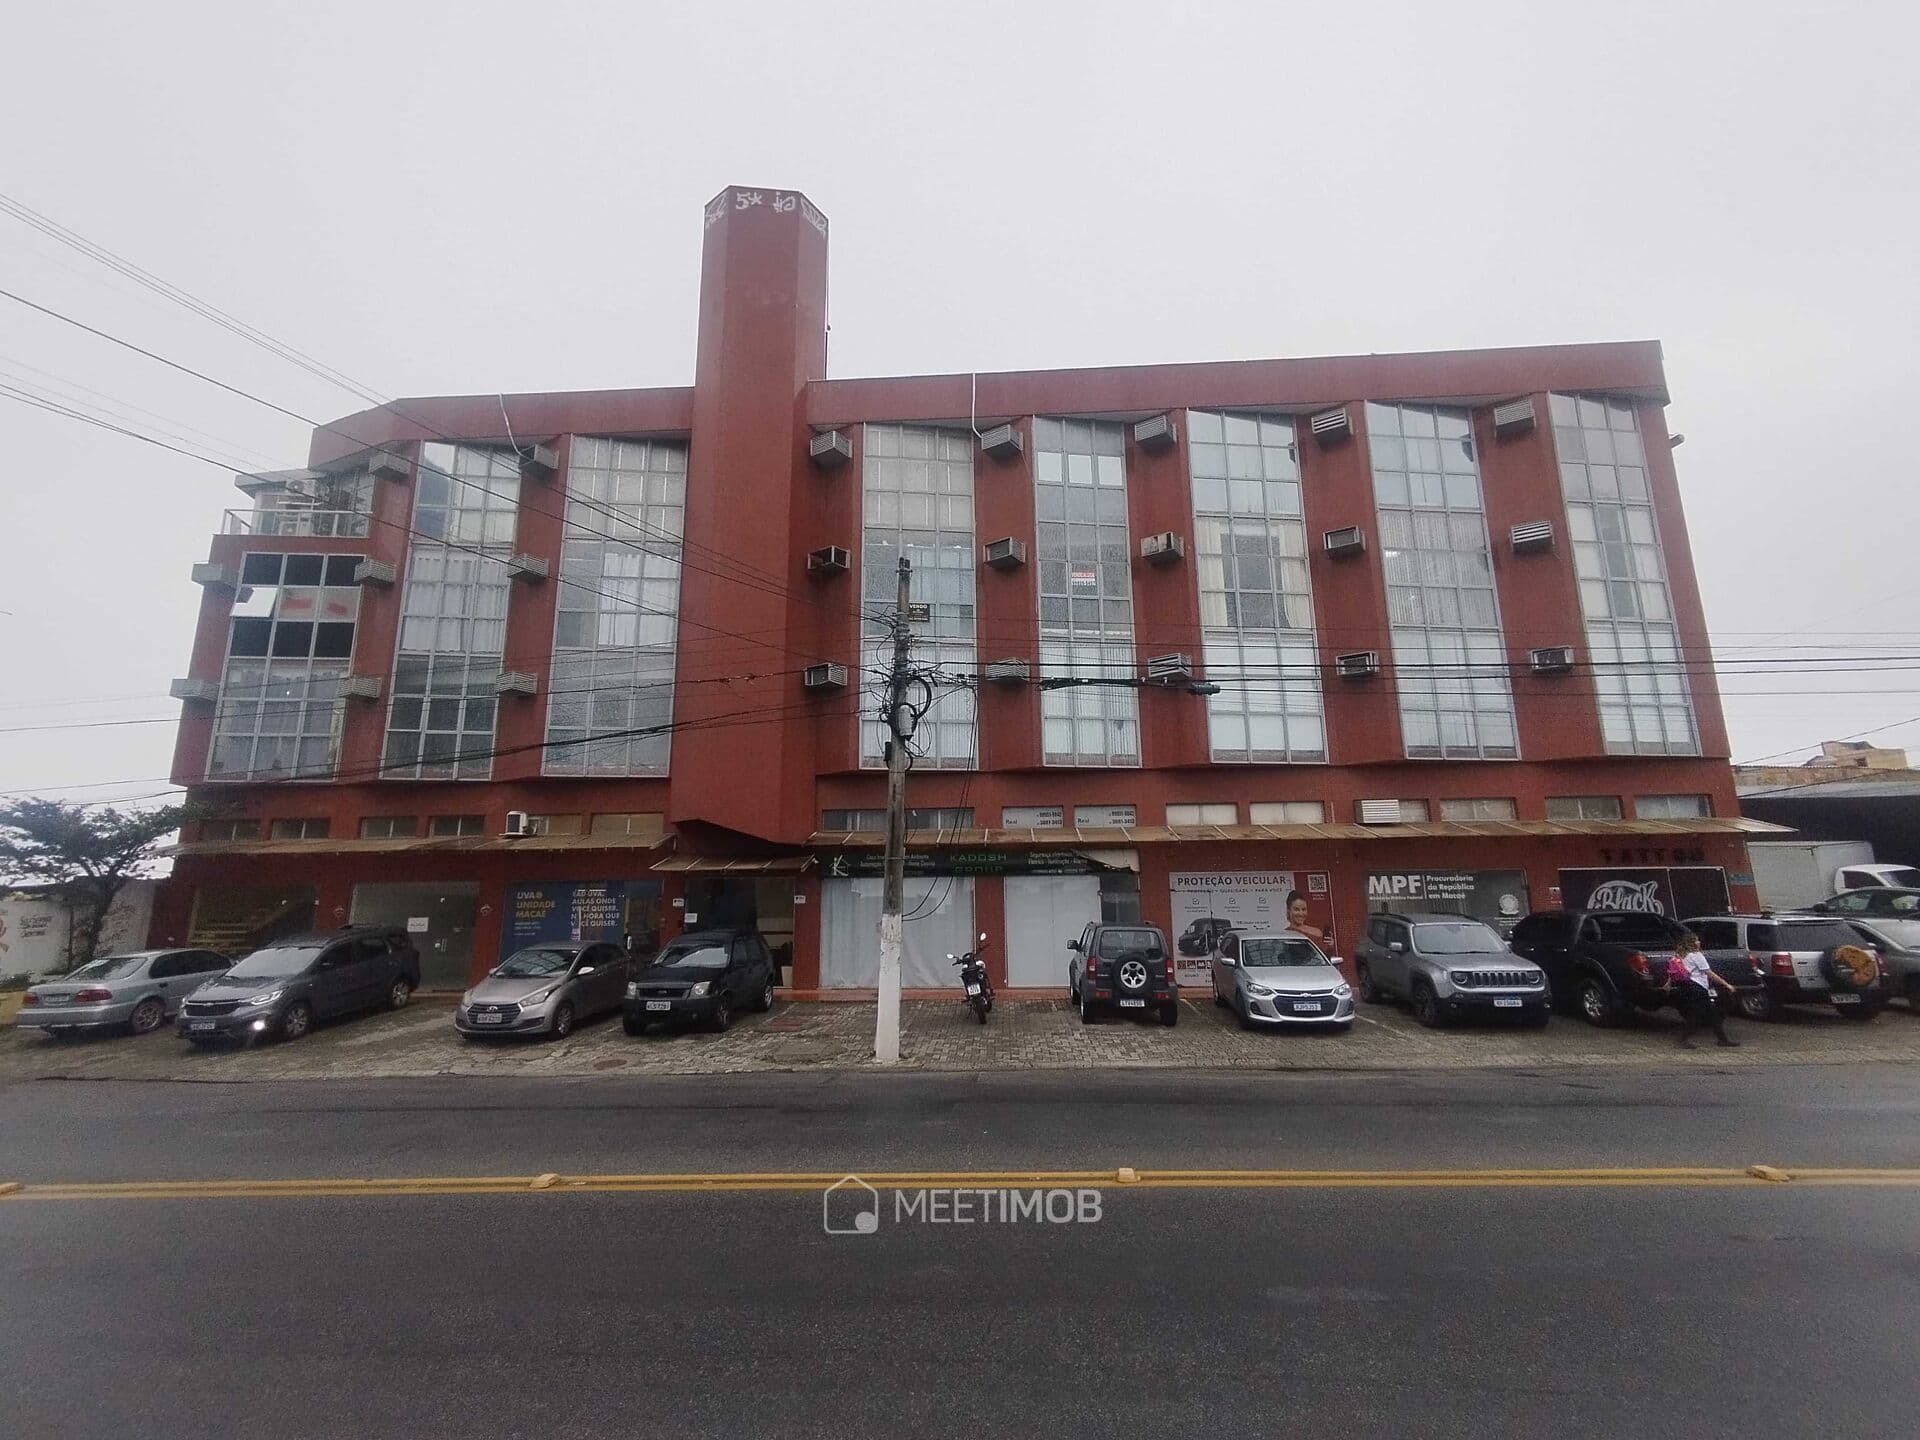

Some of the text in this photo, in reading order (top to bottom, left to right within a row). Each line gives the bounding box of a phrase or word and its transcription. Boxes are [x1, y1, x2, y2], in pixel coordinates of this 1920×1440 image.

[1177, 876, 1287, 887] PROTEÇÃO VEICULAR
[1368, 875, 1422, 894] MPF
[516, 891, 536, 899] UVA
[516, 901, 556, 909] UNIDADE
